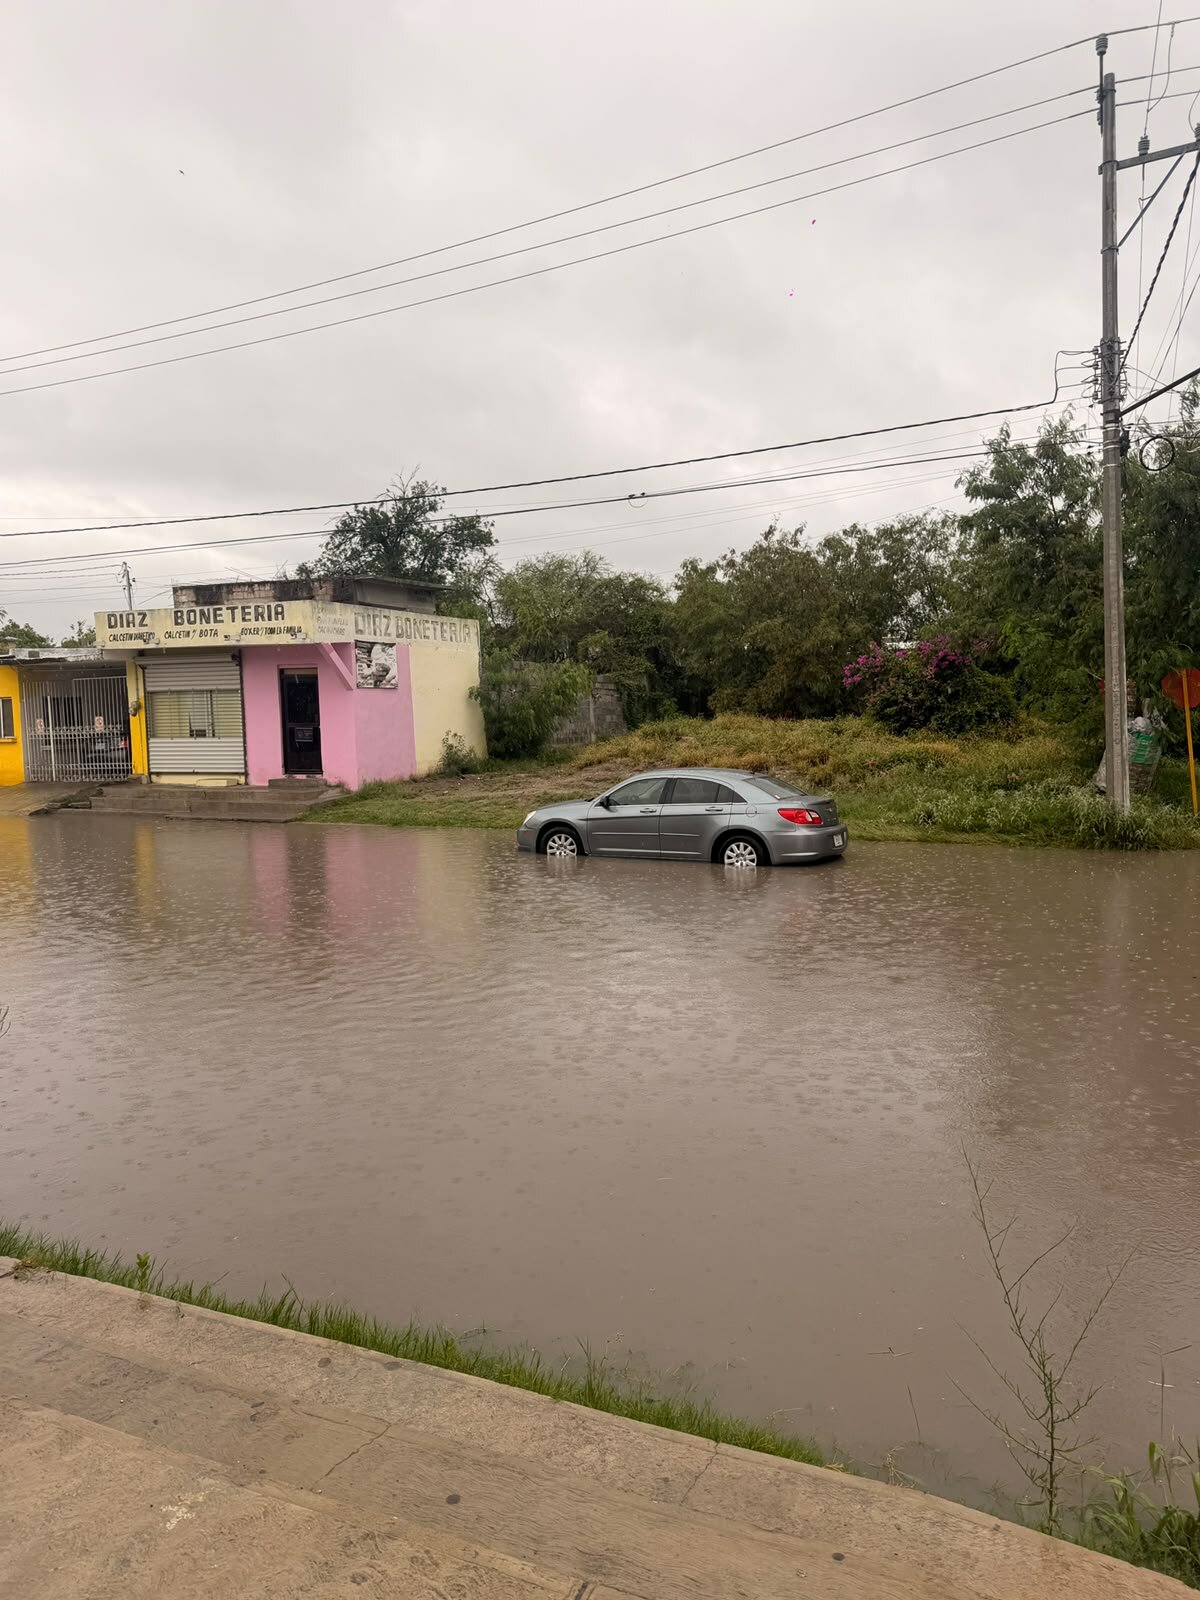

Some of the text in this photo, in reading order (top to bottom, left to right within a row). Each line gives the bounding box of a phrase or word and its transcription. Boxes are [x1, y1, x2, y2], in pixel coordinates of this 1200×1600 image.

[107, 603, 285, 629] DIAZ BONETERIA
[354, 612, 391, 637] DIAZ
[395, 617, 472, 642] BONETERIA
[164, 630, 190, 639] CALCETIN
[199, 628, 219, 638] BOTA
